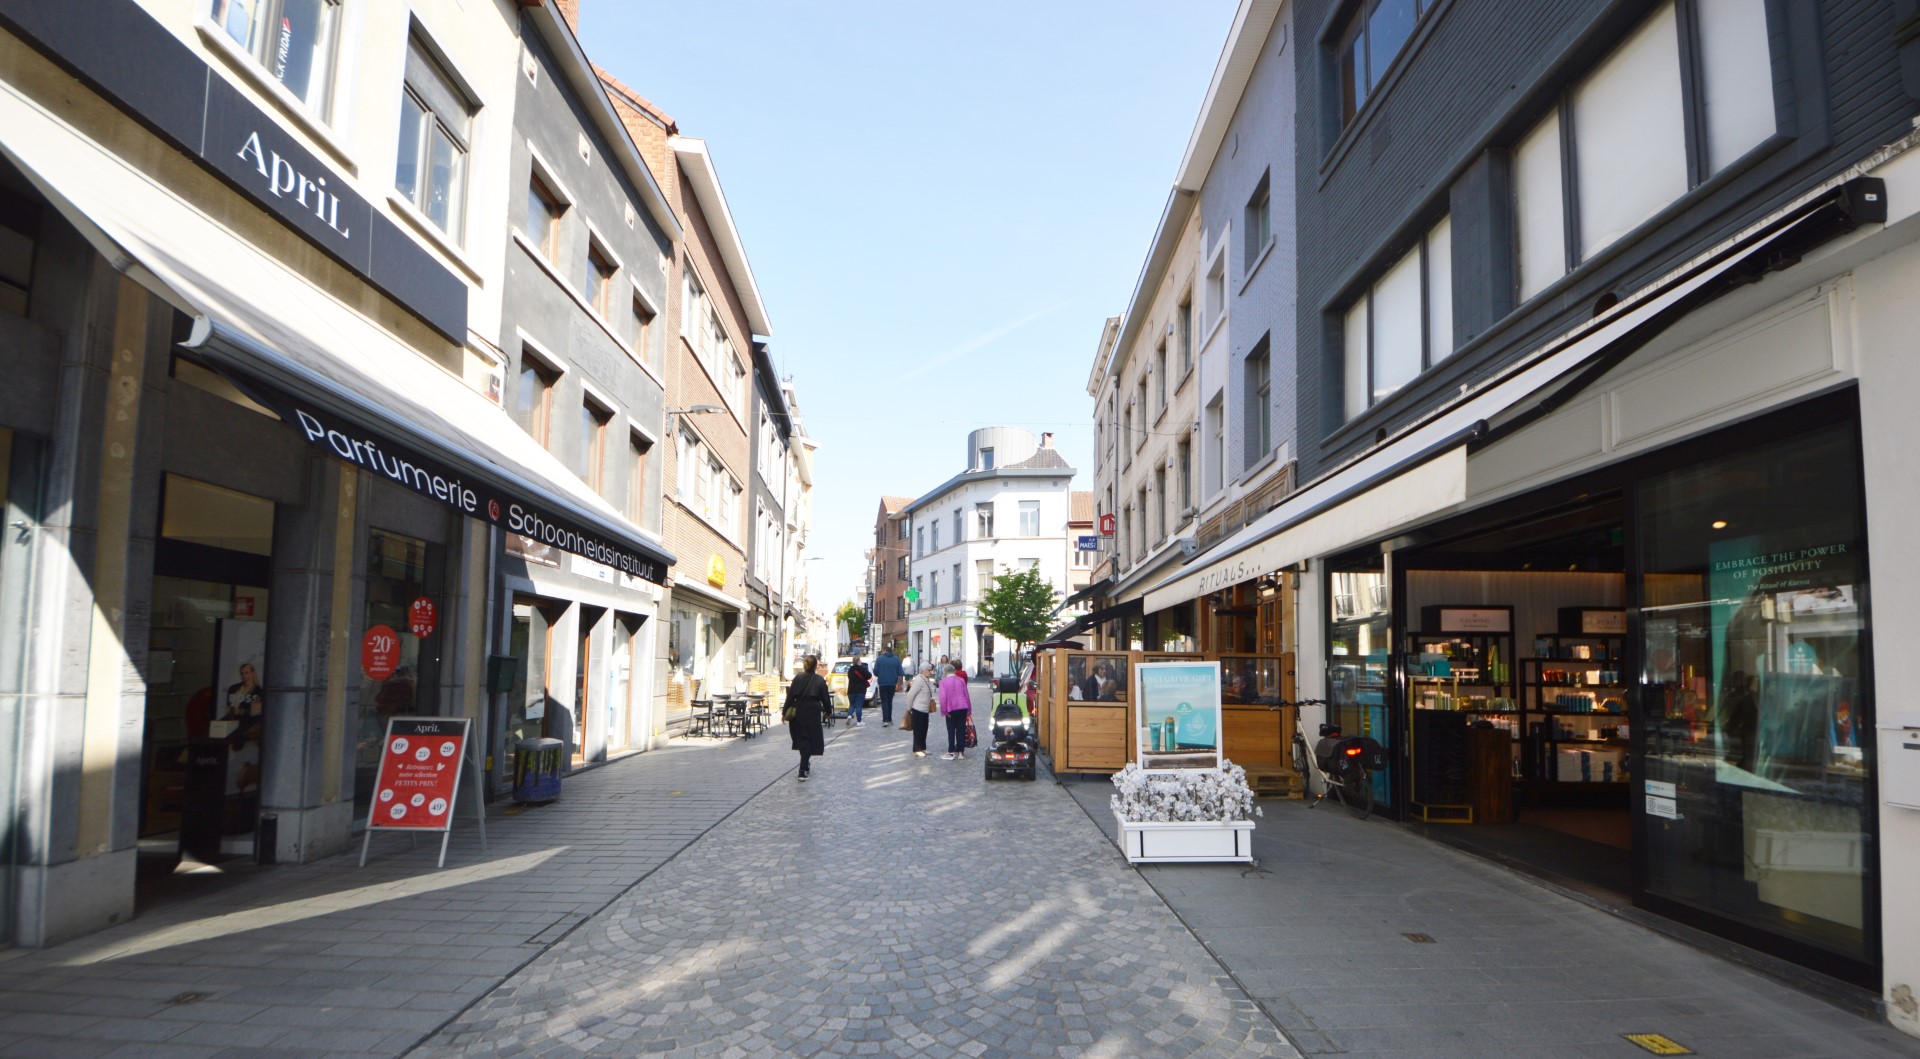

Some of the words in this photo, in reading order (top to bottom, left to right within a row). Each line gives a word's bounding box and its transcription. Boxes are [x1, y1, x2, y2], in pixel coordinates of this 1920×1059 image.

[279, 24, 291, 63] FRIDAY
[295, 408, 477, 513] Parfumerie
[508, 503, 655, 581] Schoonheidsinstituut
[1716, 555, 1767, 571] EMBRACE
[1770, 551, 1796, 563] THE
[1800, 544, 1847, 559] POWER
[1733, 570, 1748, 580] OF
[1752, 560, 1822, 577] POSITIVITY
[1747, 583, 1758, 592] The
[1760, 581, 1779, 590] Ritual
[1780, 580, 1787, 589] of
[1788, 578, 1810, 587] Karma
